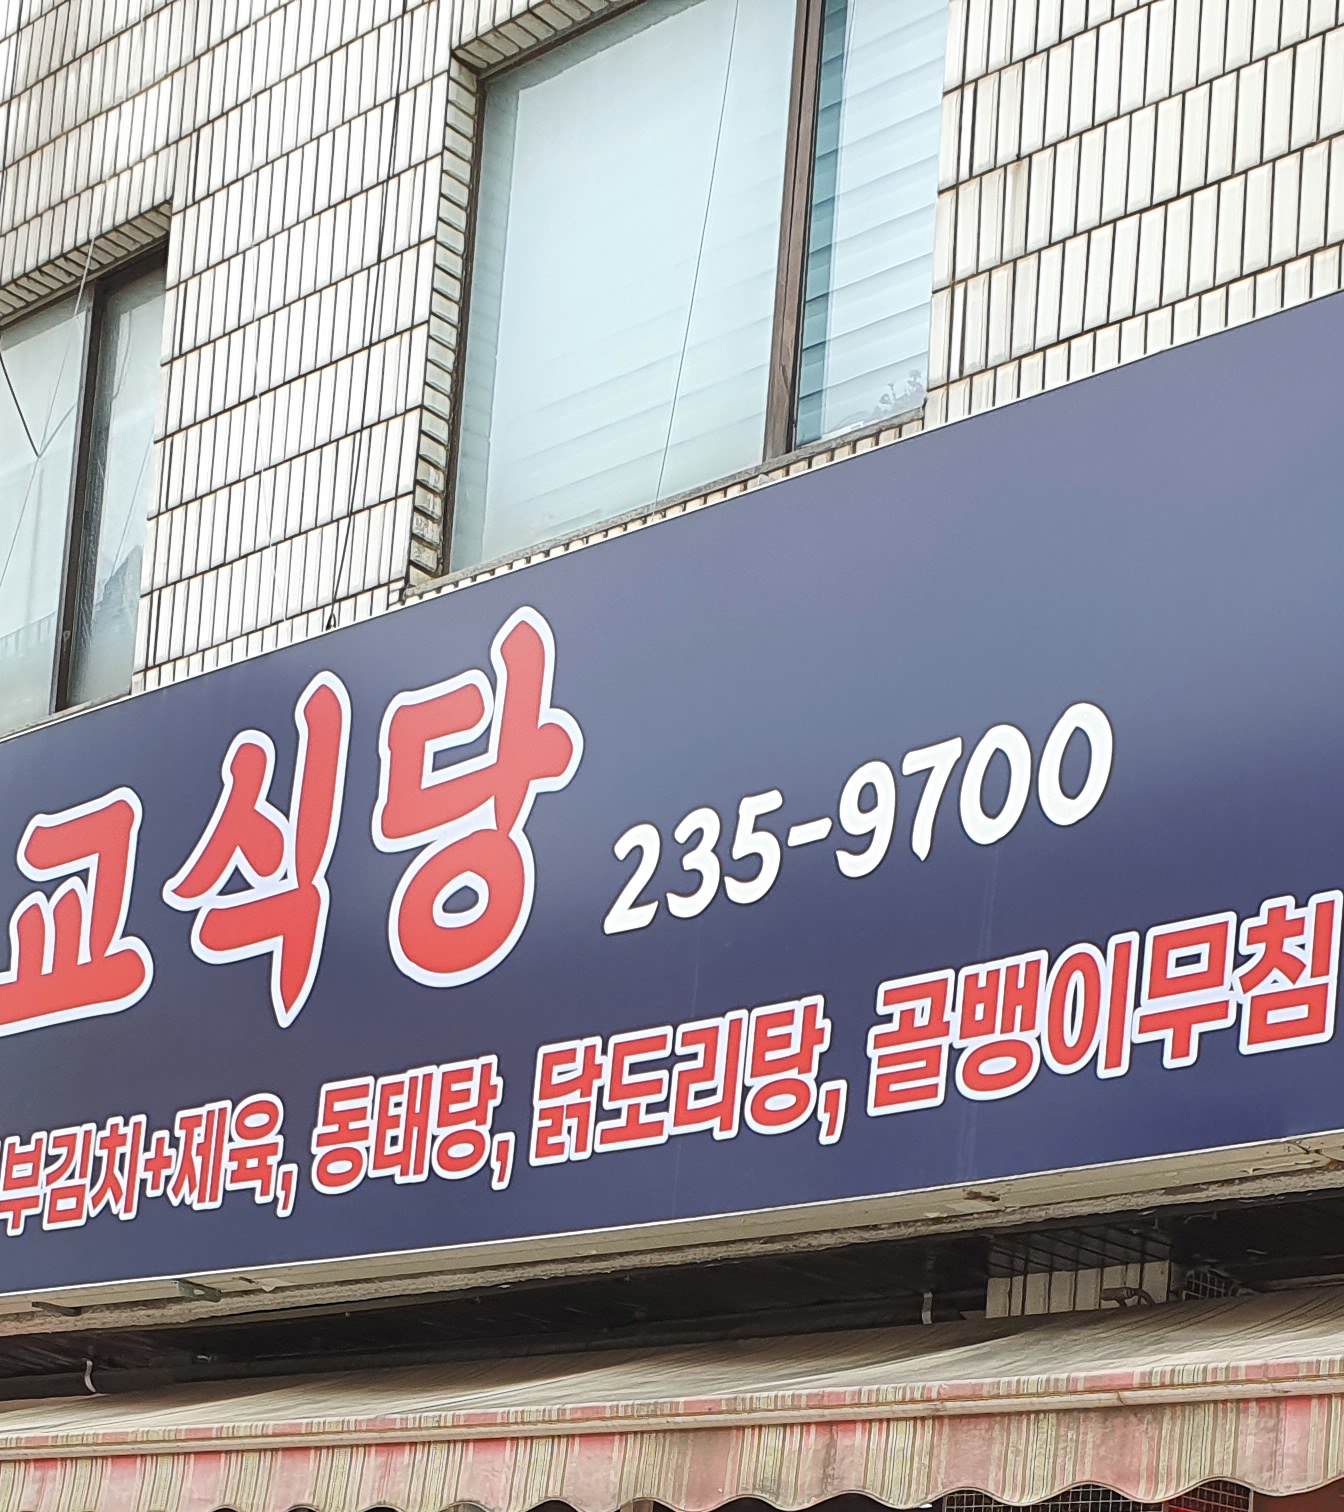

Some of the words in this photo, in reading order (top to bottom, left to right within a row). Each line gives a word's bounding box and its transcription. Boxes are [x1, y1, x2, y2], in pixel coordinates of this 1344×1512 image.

[603, 702, 1114, 935] 235-9700
[311, 1054, 517, 1196] 동태탕,
[529, 994, 847, 1168] 닭도리탕,
[866, 889, 1344, 1118] 골뱅이무침
